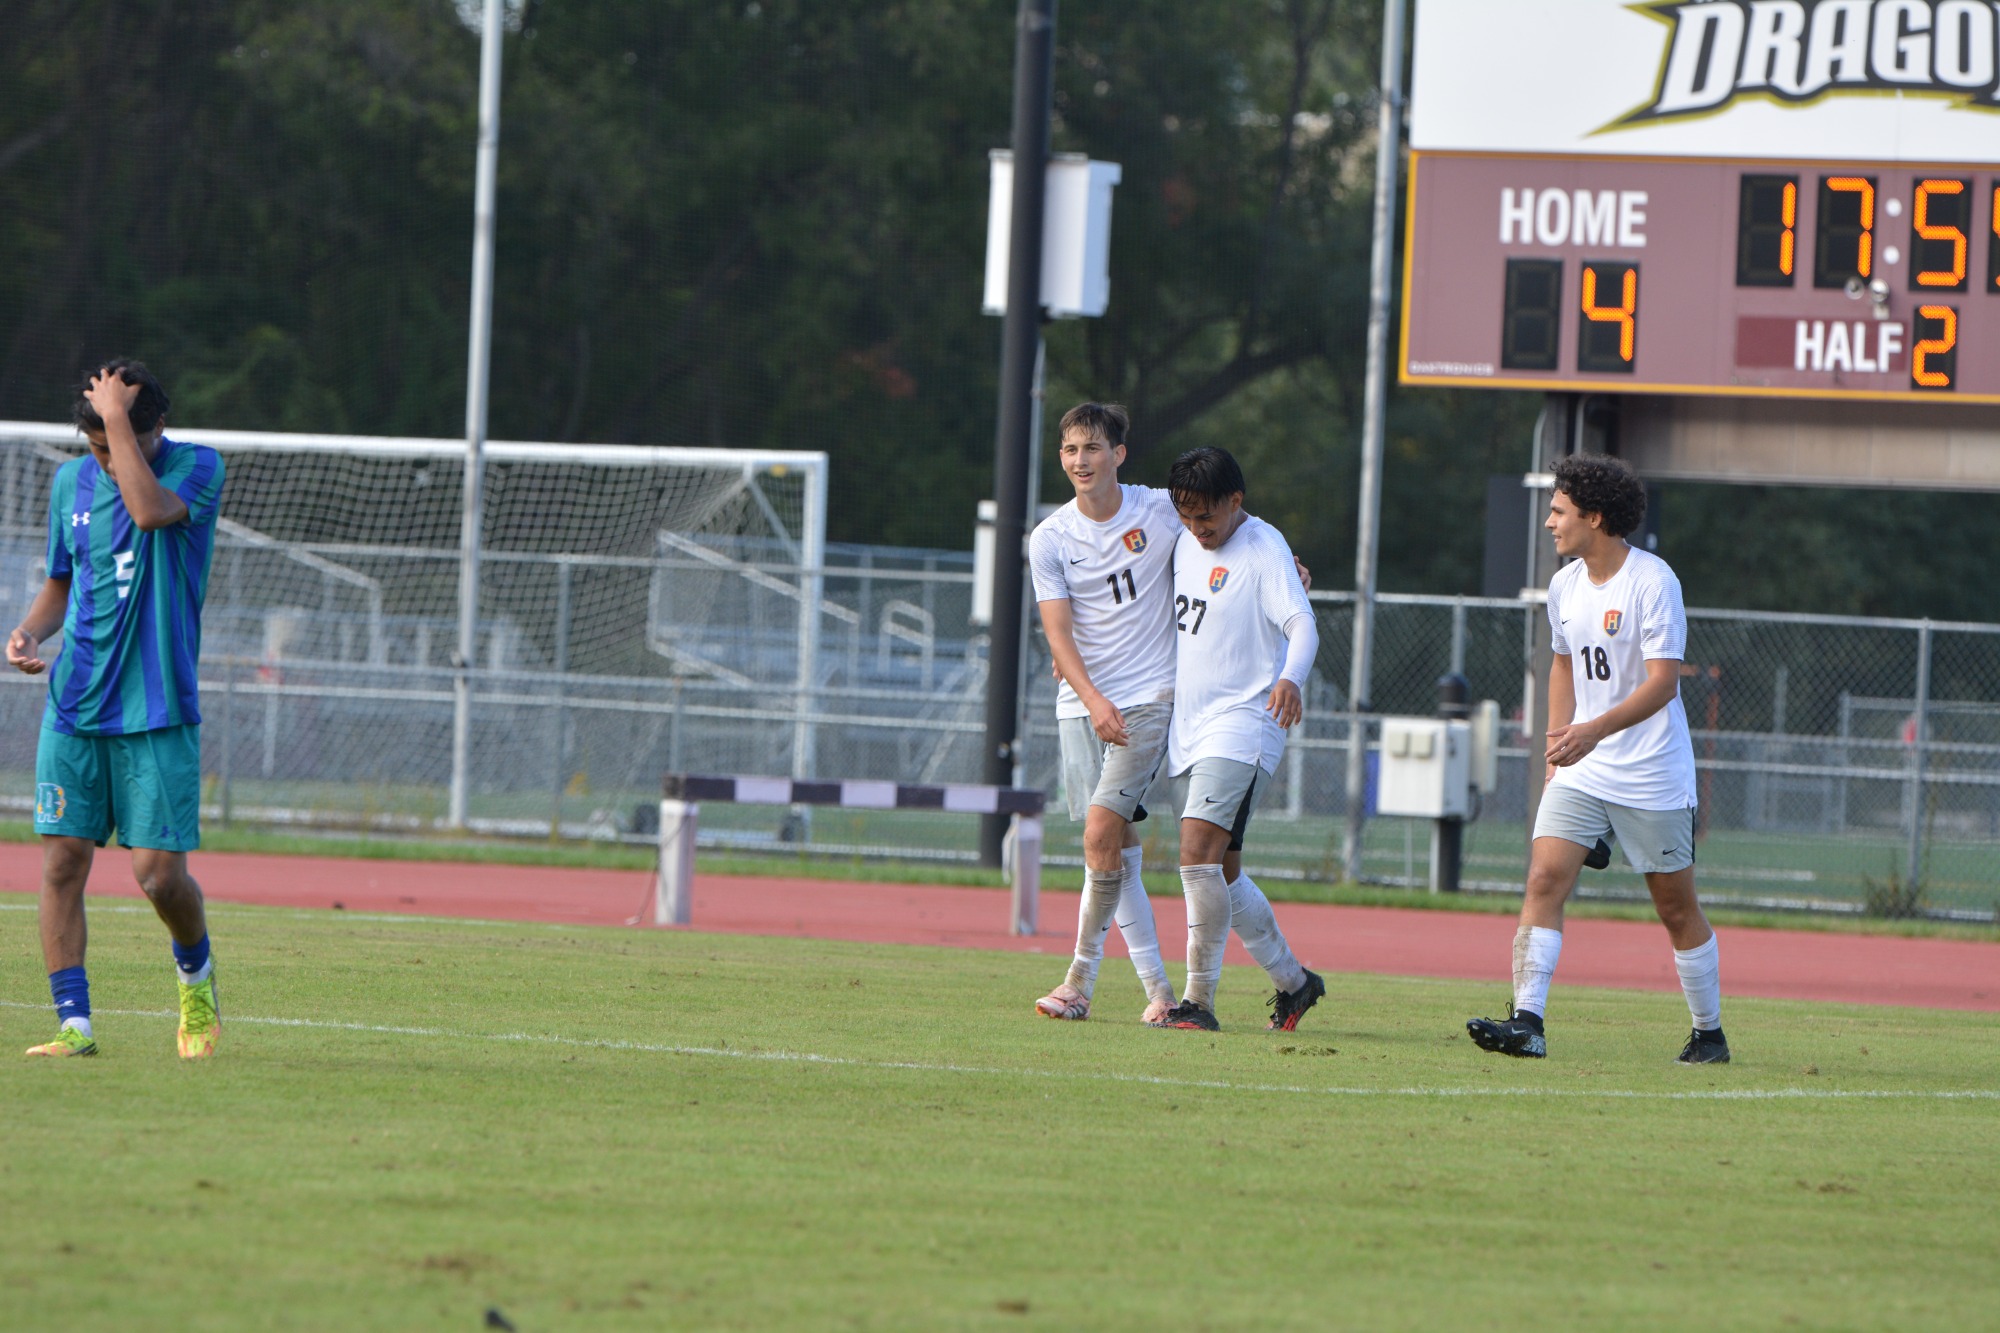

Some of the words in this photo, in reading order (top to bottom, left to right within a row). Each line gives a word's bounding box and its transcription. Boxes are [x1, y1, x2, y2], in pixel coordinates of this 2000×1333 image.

[1654, 0, 2000, 114] DRAGO
[1500, 187, 1649, 248] HOME
[1780, 177, 2000, 287] 17:5
[1581, 267, 1637, 362] 4
[1794, 320, 1904, 374] HALF
[1911, 304, 1957, 387] 2
[112, 550, 135, 599] 5
[1106, 568, 1138, 605] 11
[1175, 594, 1207, 635] 27
[1580, 646, 1611, 681] 18
